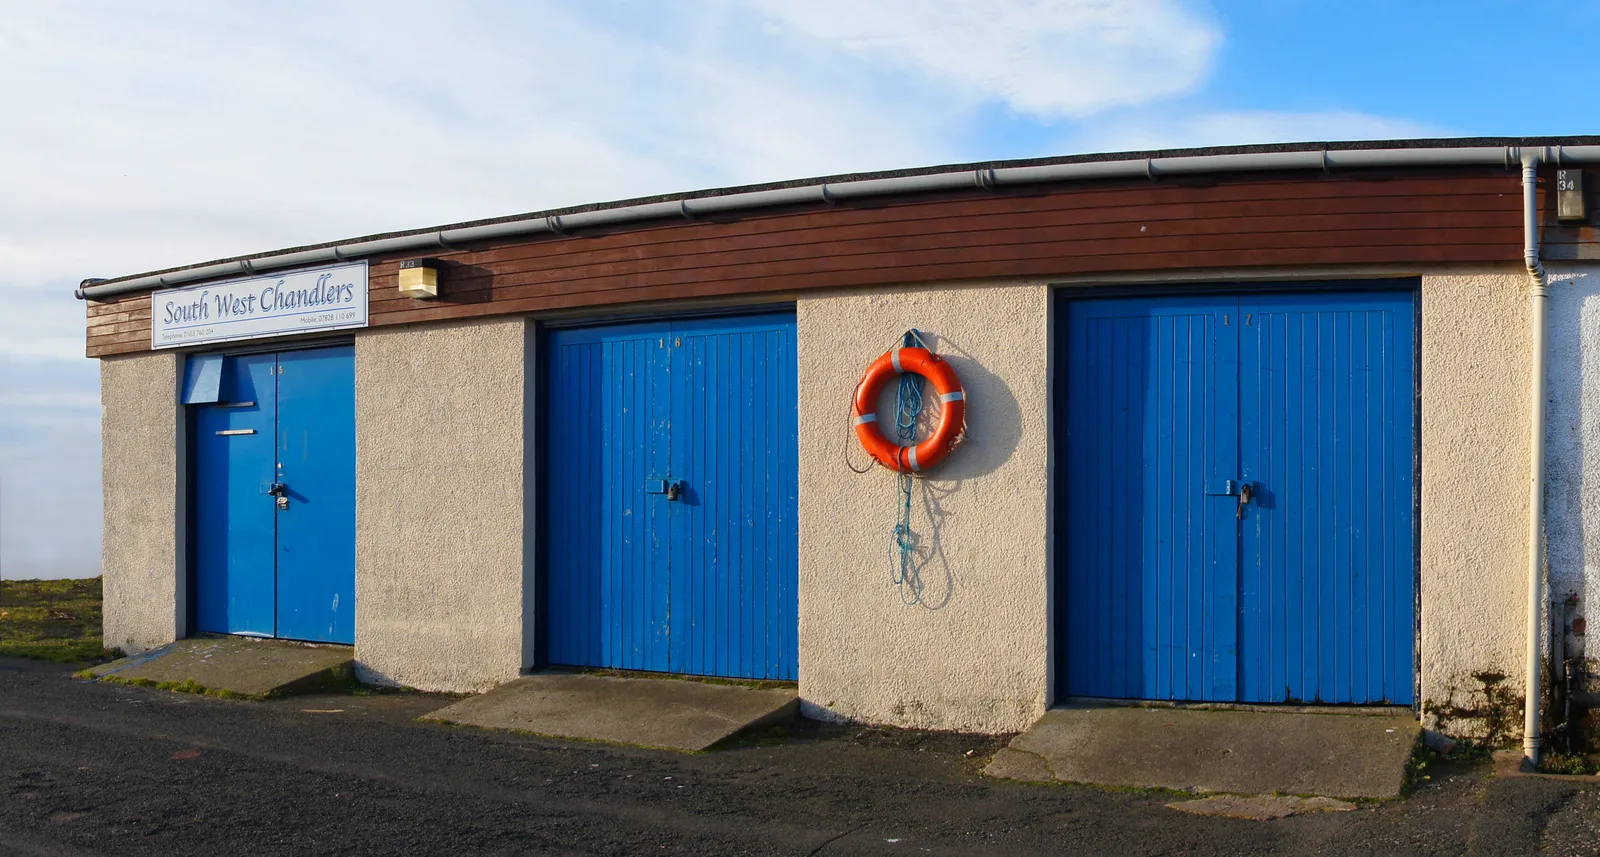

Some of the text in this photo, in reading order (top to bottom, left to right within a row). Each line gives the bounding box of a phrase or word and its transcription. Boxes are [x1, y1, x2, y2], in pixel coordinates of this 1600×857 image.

[1559, 180, 1575, 190] 34
[400, 260, 415, 269] R33
[164, 272, 354, 325] South West Chandlers
